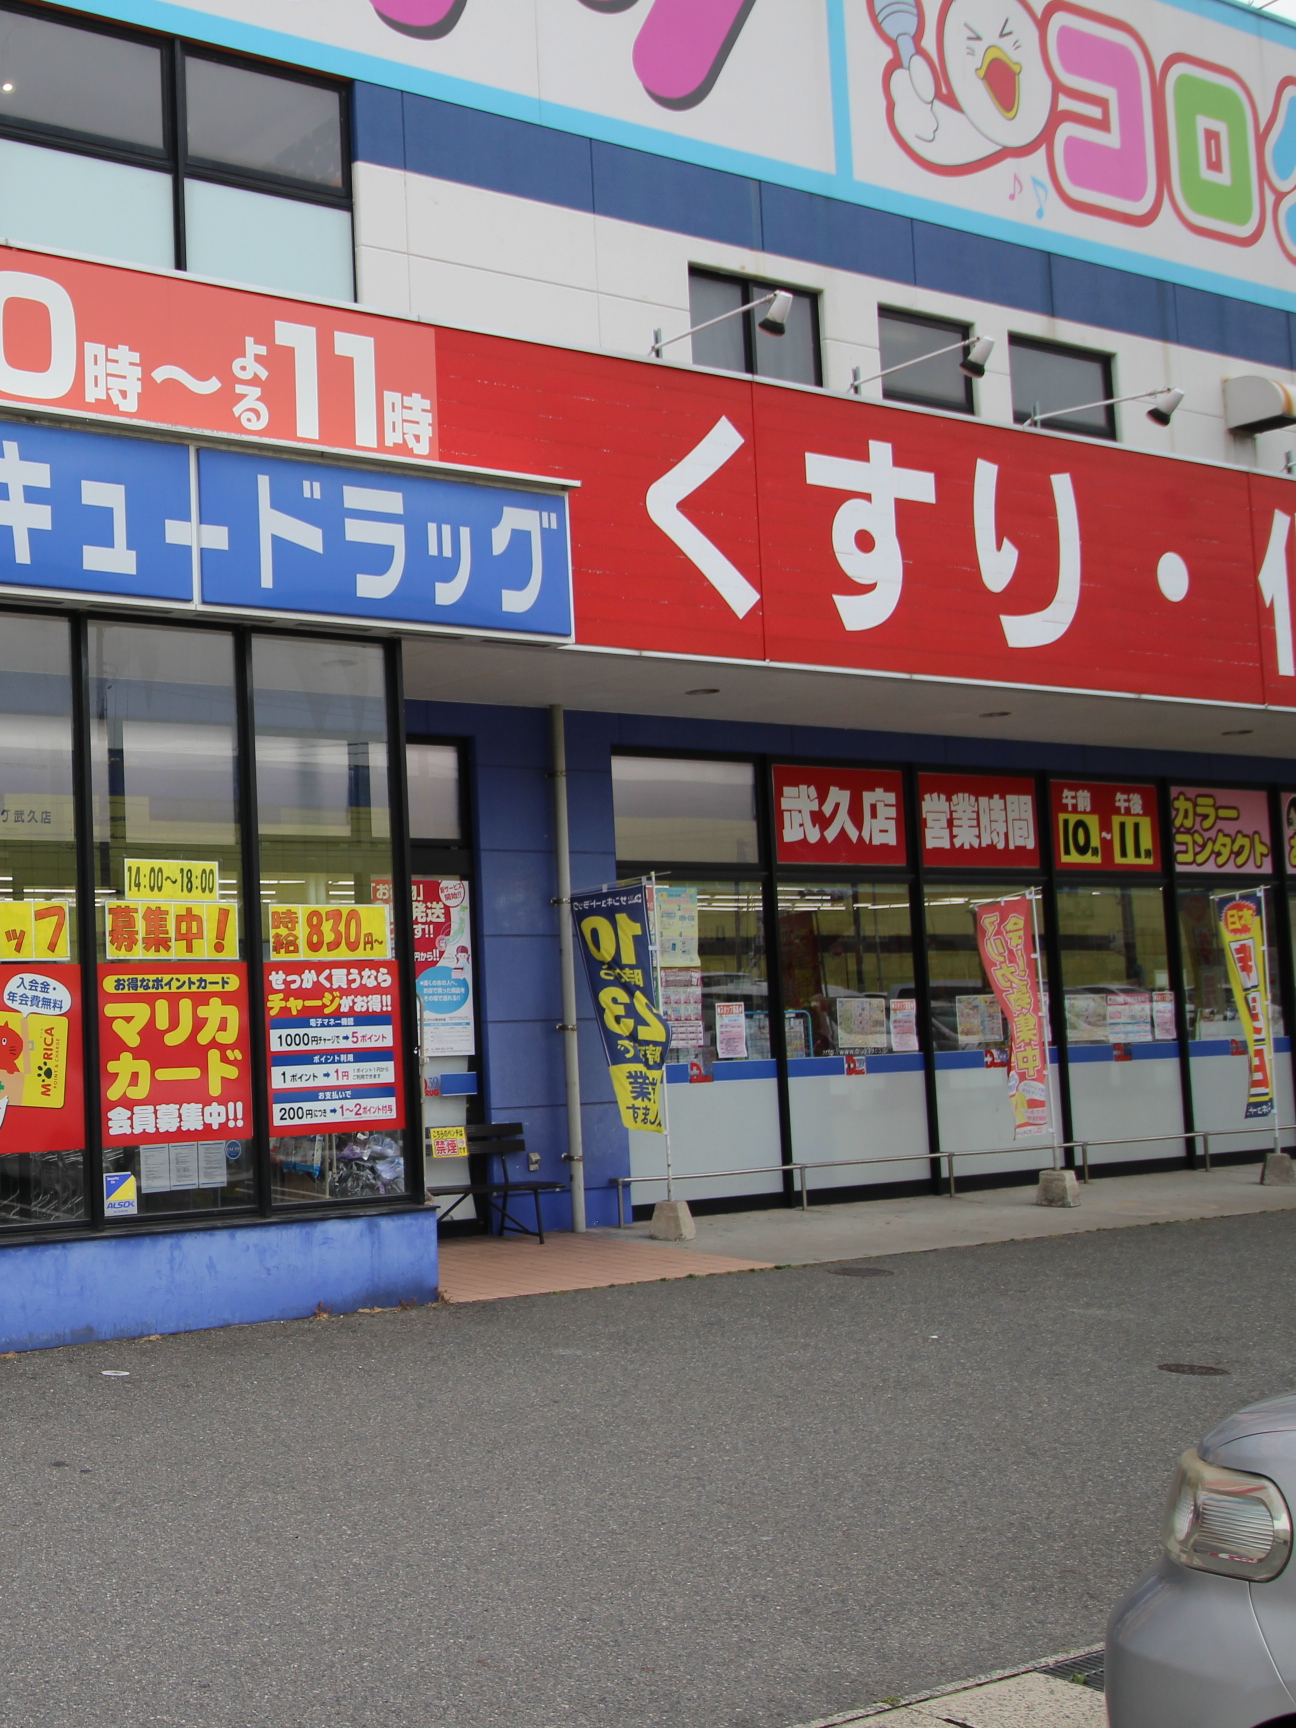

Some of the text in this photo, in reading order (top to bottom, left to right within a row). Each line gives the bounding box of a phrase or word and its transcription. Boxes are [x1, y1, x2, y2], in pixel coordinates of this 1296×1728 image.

[646, 415, 1296, 677] くすり・
[1061, 788, 1091, 812] 午前
[1114, 791, 1143, 815] 午後
[1172, 791, 1240, 832] カラー
[13, 809, 52, 825] 武久店
[781, 784, 897, 846] 武久店
[921, 792, 1035, 850] 営業時間
[1173, 828, 1271, 869] コンタクト
[114, 976, 230, 991] お得なポイントカード
[268, 967, 392, 989] せっかく買うなら
[6, 991, 63, 1012] 年会費無料
[104, 997, 240, 1048] マリカ
[277, 1031, 387, 1047] 1000円チャージで 5ポイント
[313, 1053, 354, 1063] ポイント利用
[106, 1048, 243, 1101] カード
[318, 1090, 352, 1099] お支払いで
[279, 1106, 327, 1121] 200円につき
[106, 1200, 135, 1209] ALSOK
